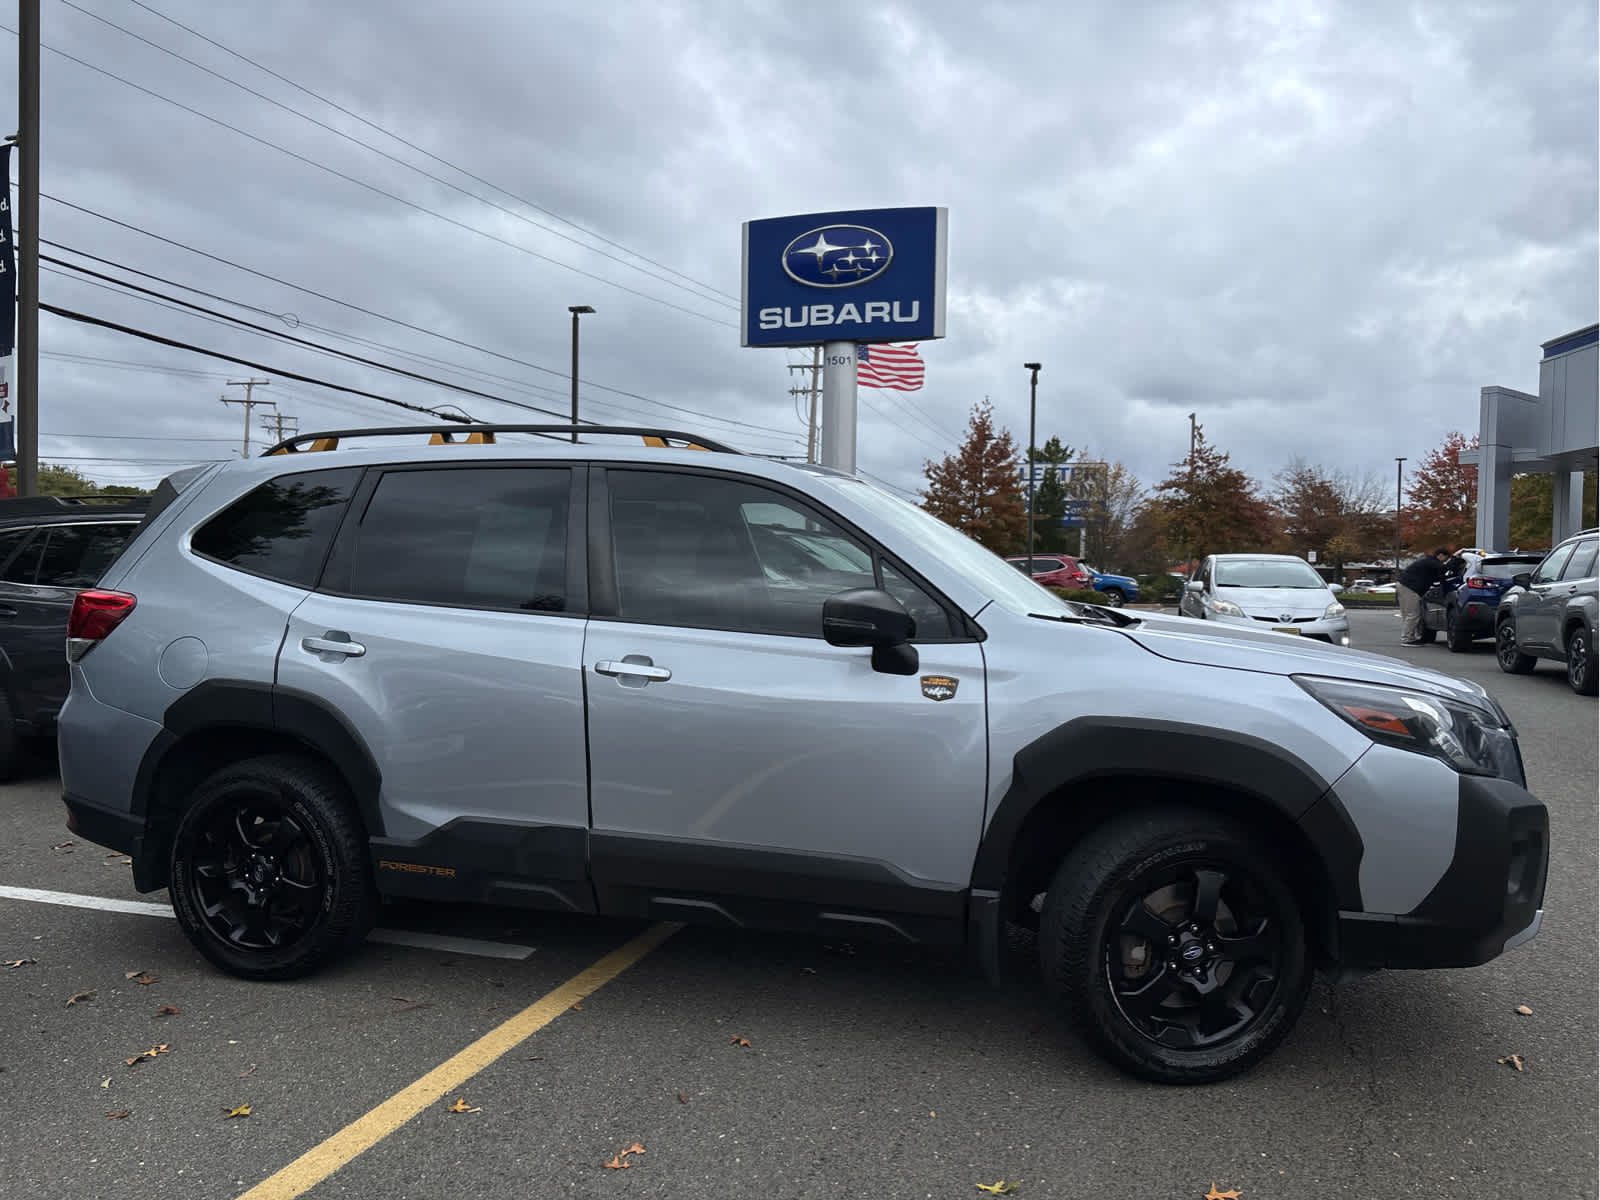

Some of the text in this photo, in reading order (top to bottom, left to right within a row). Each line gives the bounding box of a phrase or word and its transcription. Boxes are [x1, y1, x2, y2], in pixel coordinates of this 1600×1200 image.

[759, 300, 920, 330] SUBARU
[826, 355, 852, 366] 1501
[379, 860, 457, 879] FORESTER
